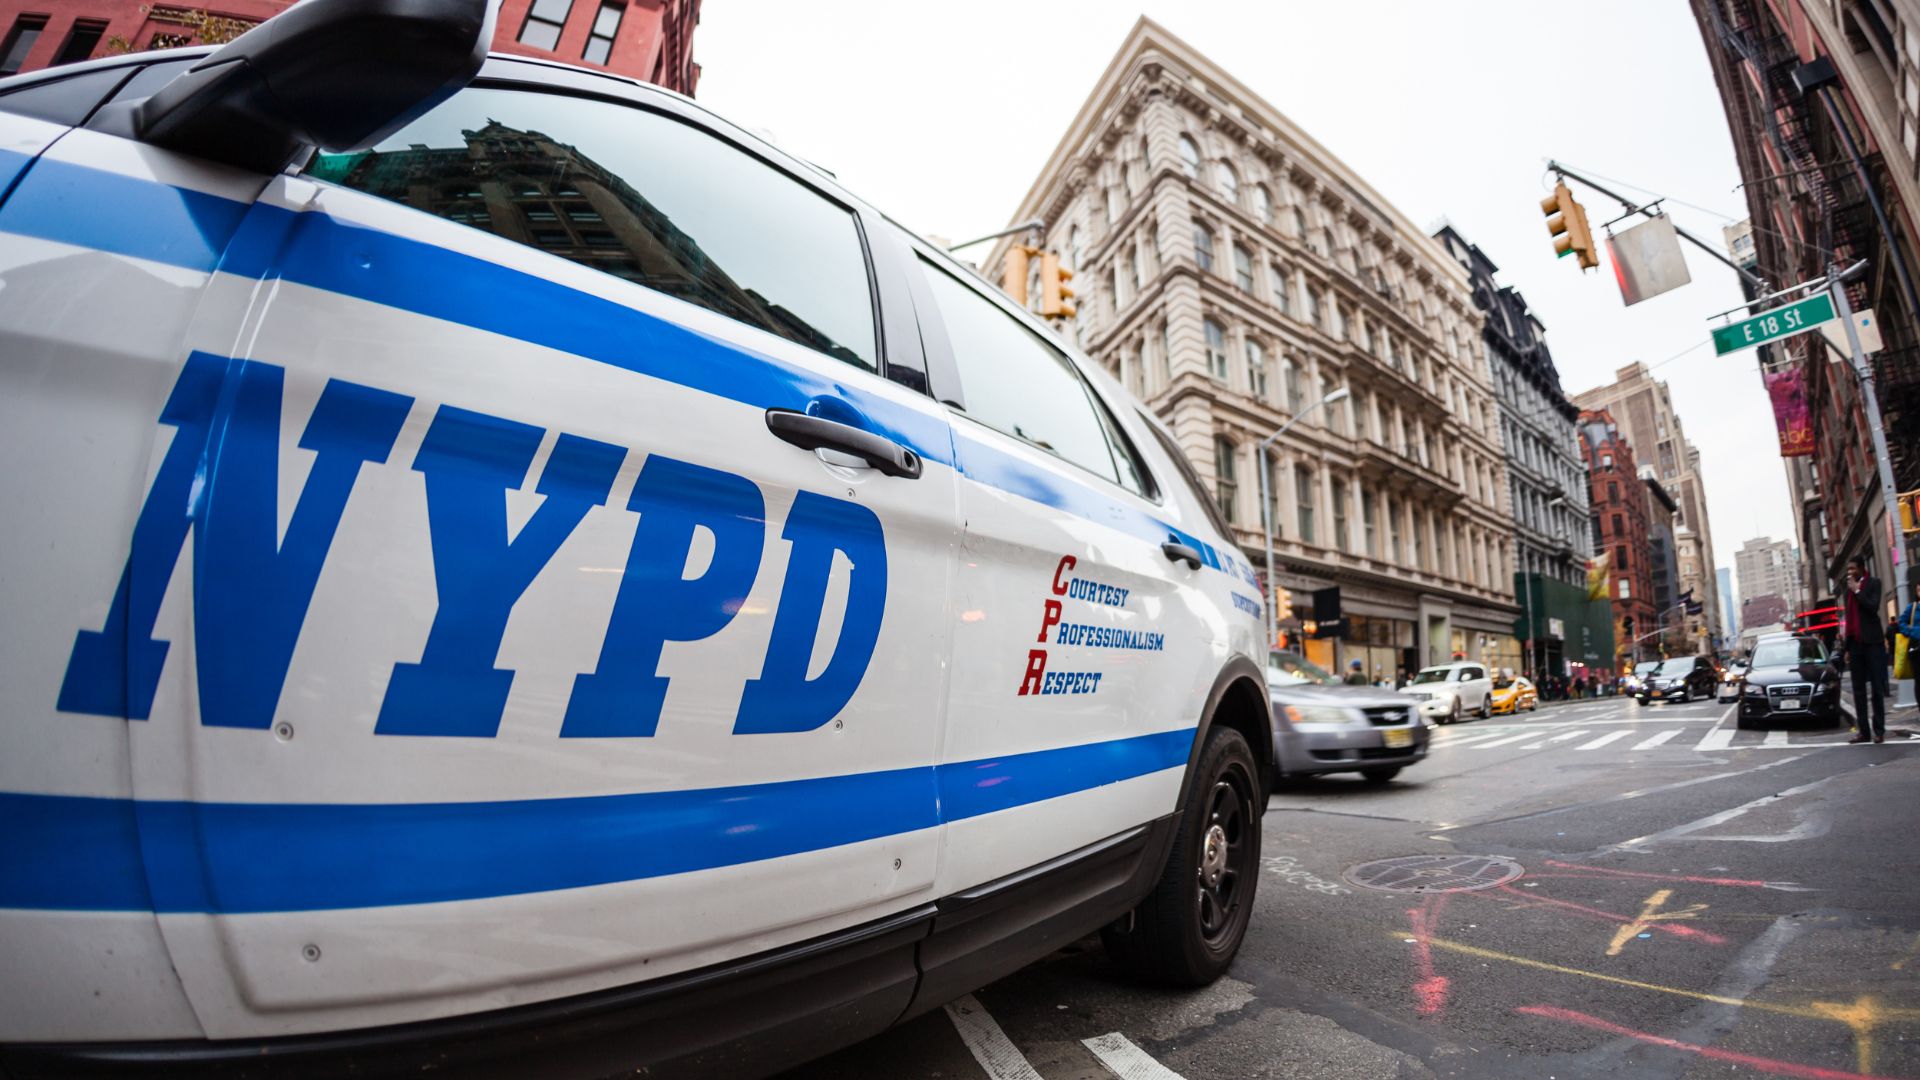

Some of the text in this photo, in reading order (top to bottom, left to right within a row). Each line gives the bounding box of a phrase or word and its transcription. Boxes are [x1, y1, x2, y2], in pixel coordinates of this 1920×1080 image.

[1743, 308, 1804, 342] E 18 St
[1779, 417, 1812, 445] abc
[57, 350, 888, 739] NYPD
[1052, 554, 1129, 608] COURTESY
[1037, 599, 1164, 651] PROFESSIONALISM
[1018, 649, 1102, 696] RESPECT
